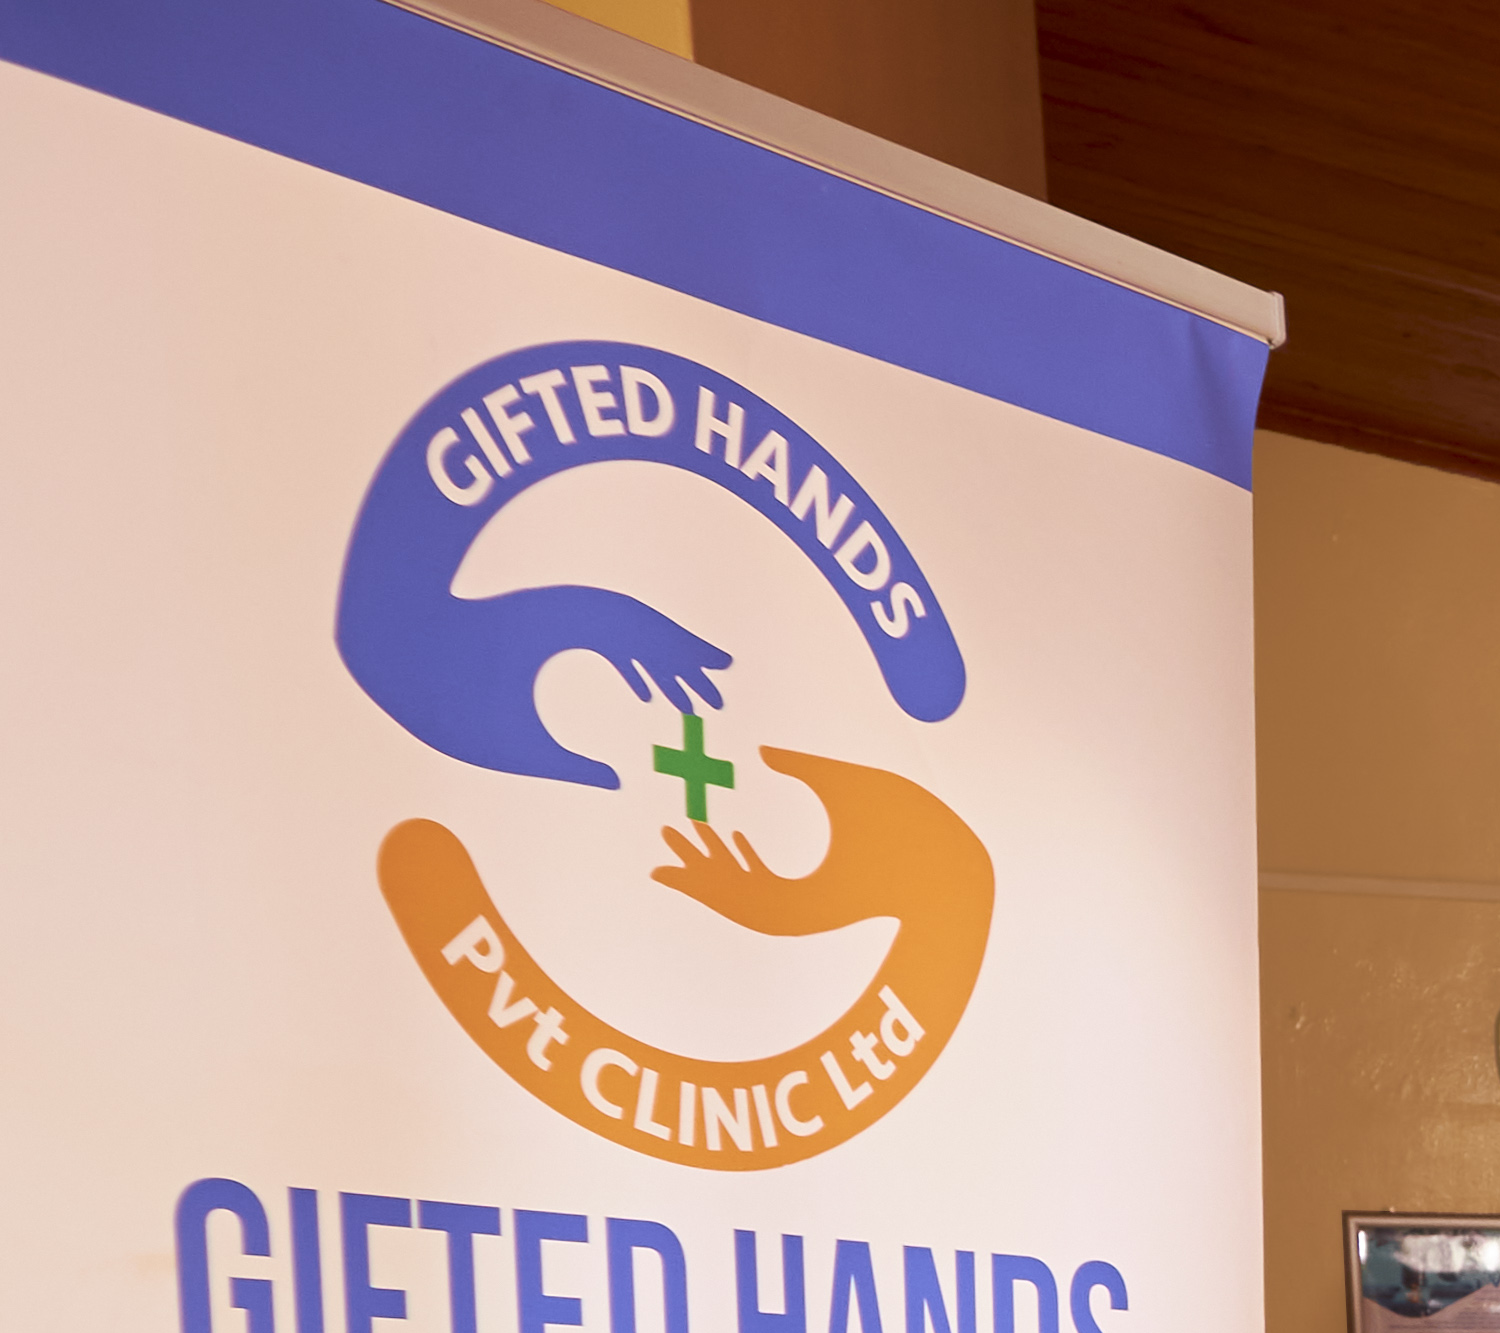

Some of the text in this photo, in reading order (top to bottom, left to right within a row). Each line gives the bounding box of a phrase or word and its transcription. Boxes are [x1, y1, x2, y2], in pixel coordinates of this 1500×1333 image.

[426, 365, 926, 639] GIFTED HANDS
[441, 915, 926, 1152] Pvt CLINIC Ltd
